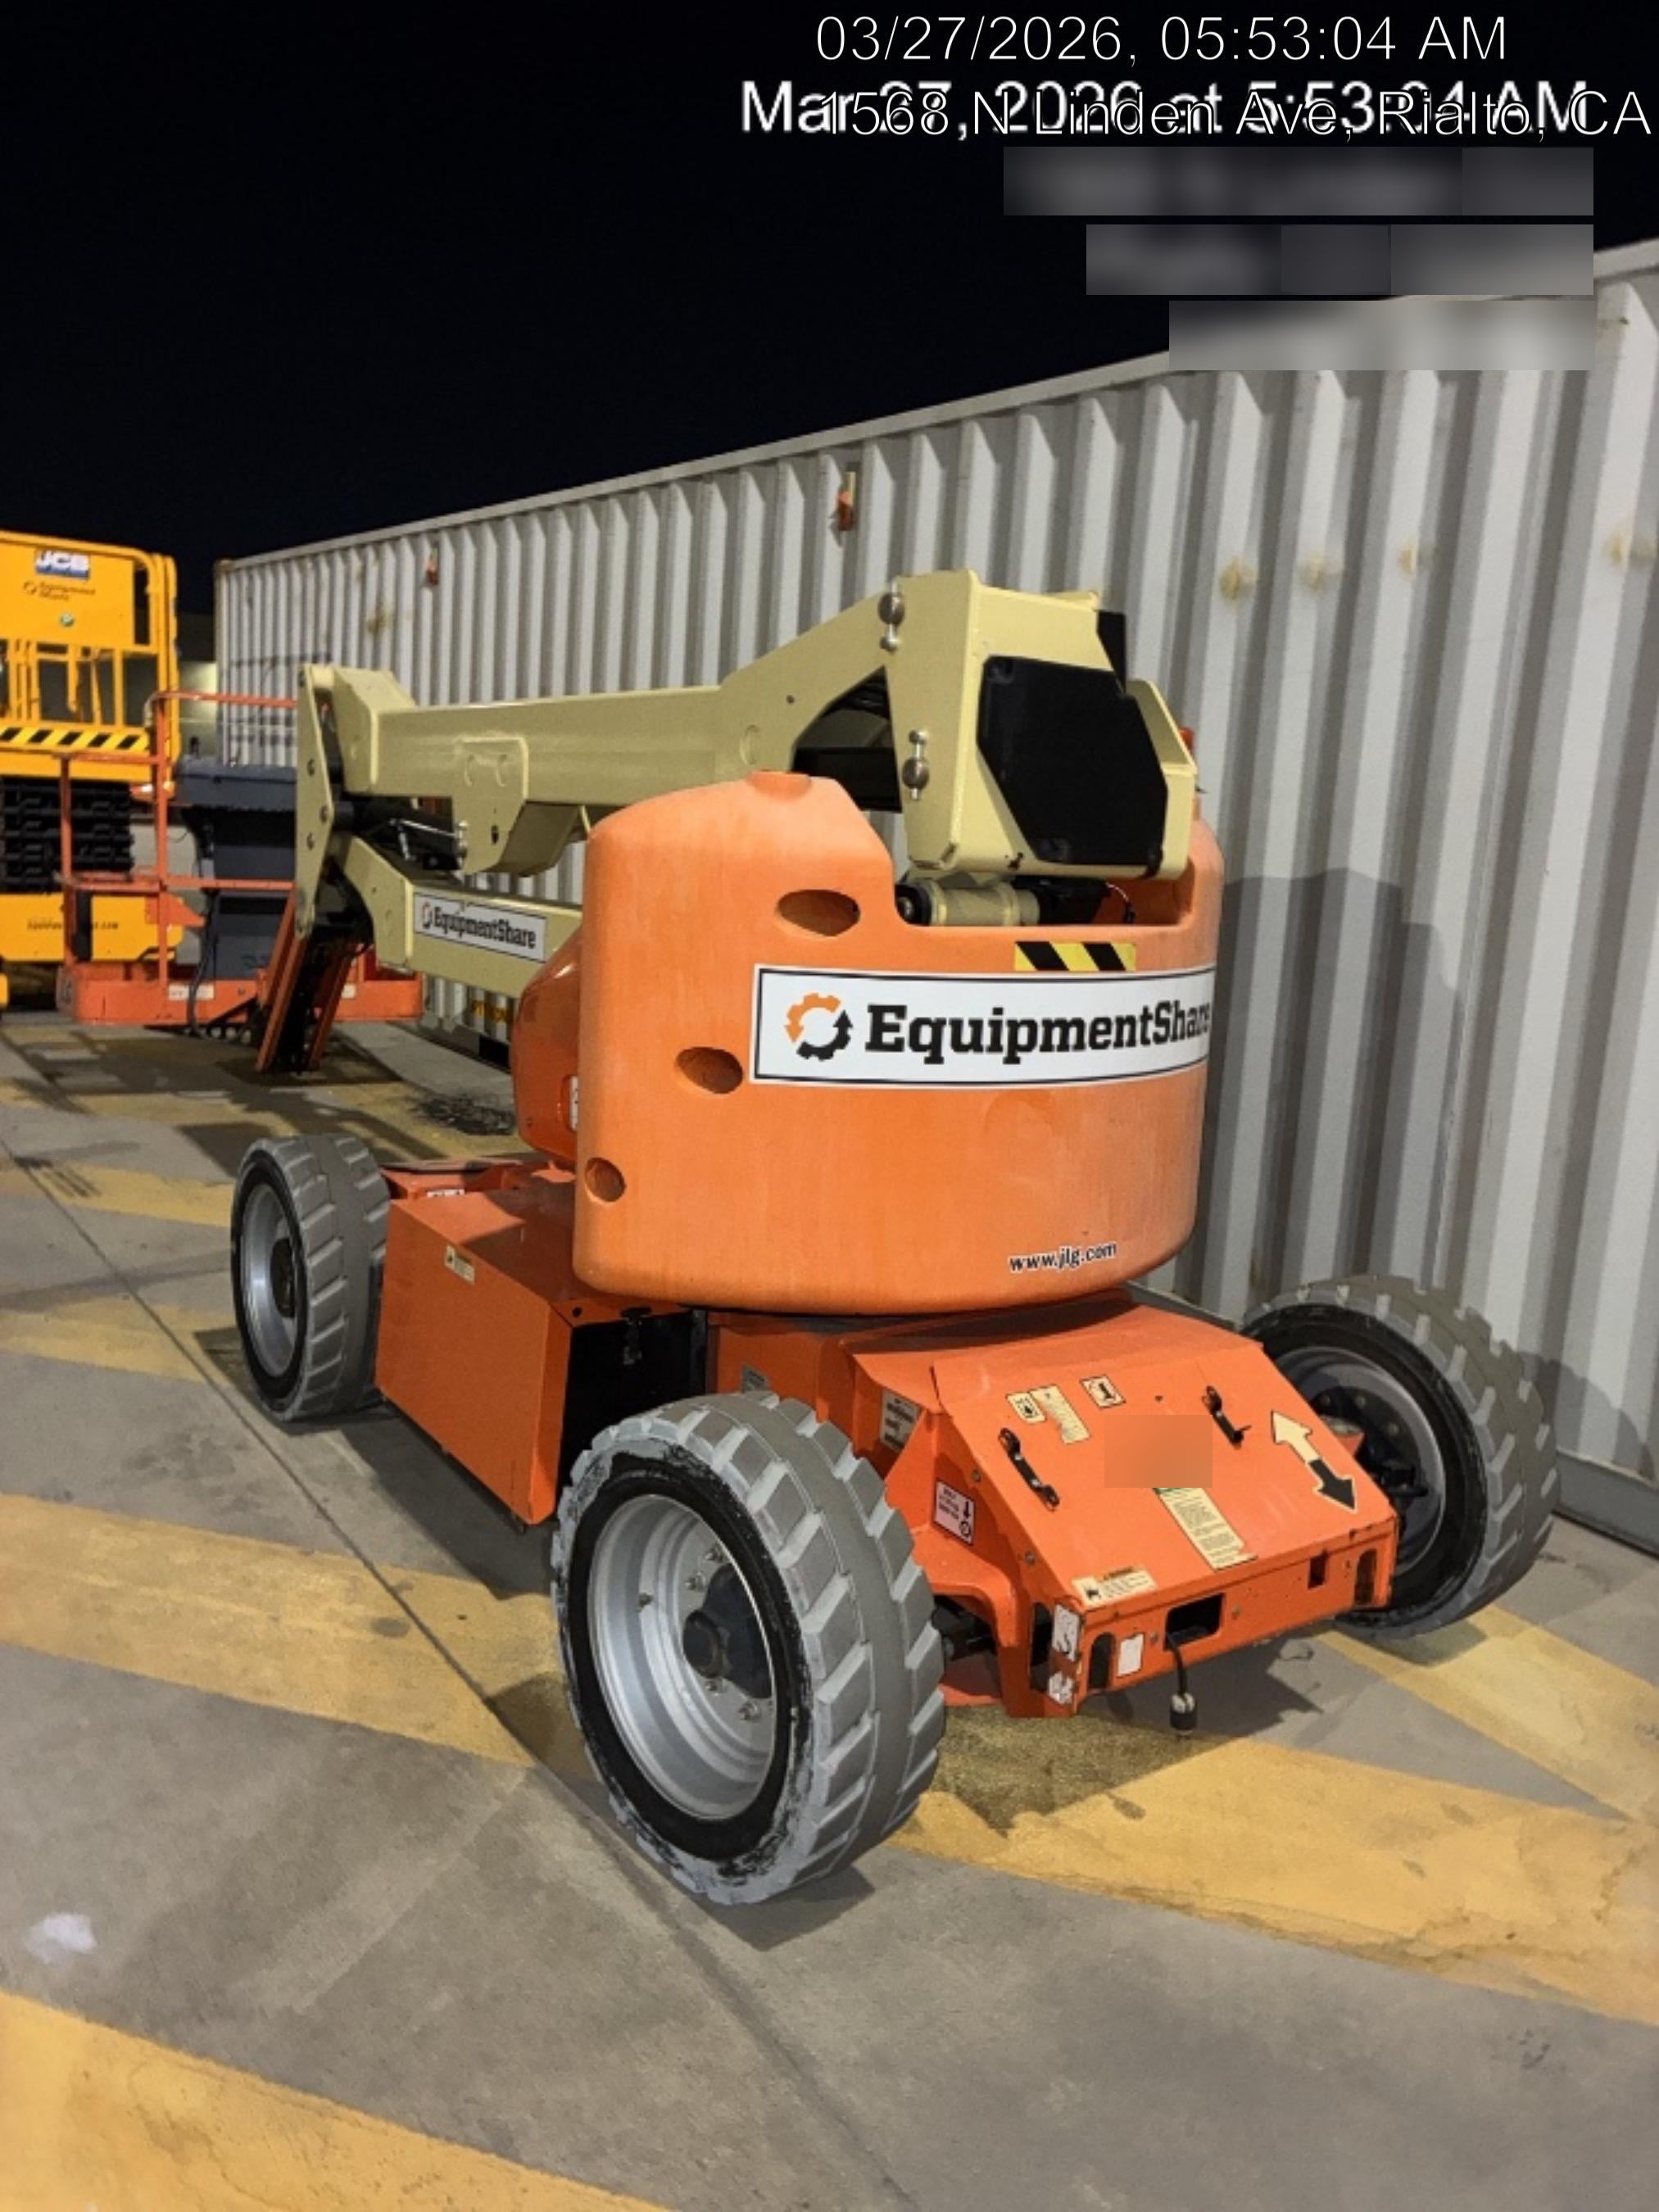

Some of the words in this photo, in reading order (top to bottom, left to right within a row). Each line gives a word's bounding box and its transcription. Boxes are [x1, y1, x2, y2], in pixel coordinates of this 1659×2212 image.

[36, 550, 90, 573] JCB
[433, 906, 537, 949] EquipmentShare
[1009, 1241, 1117, 1272] www.jlg.com
